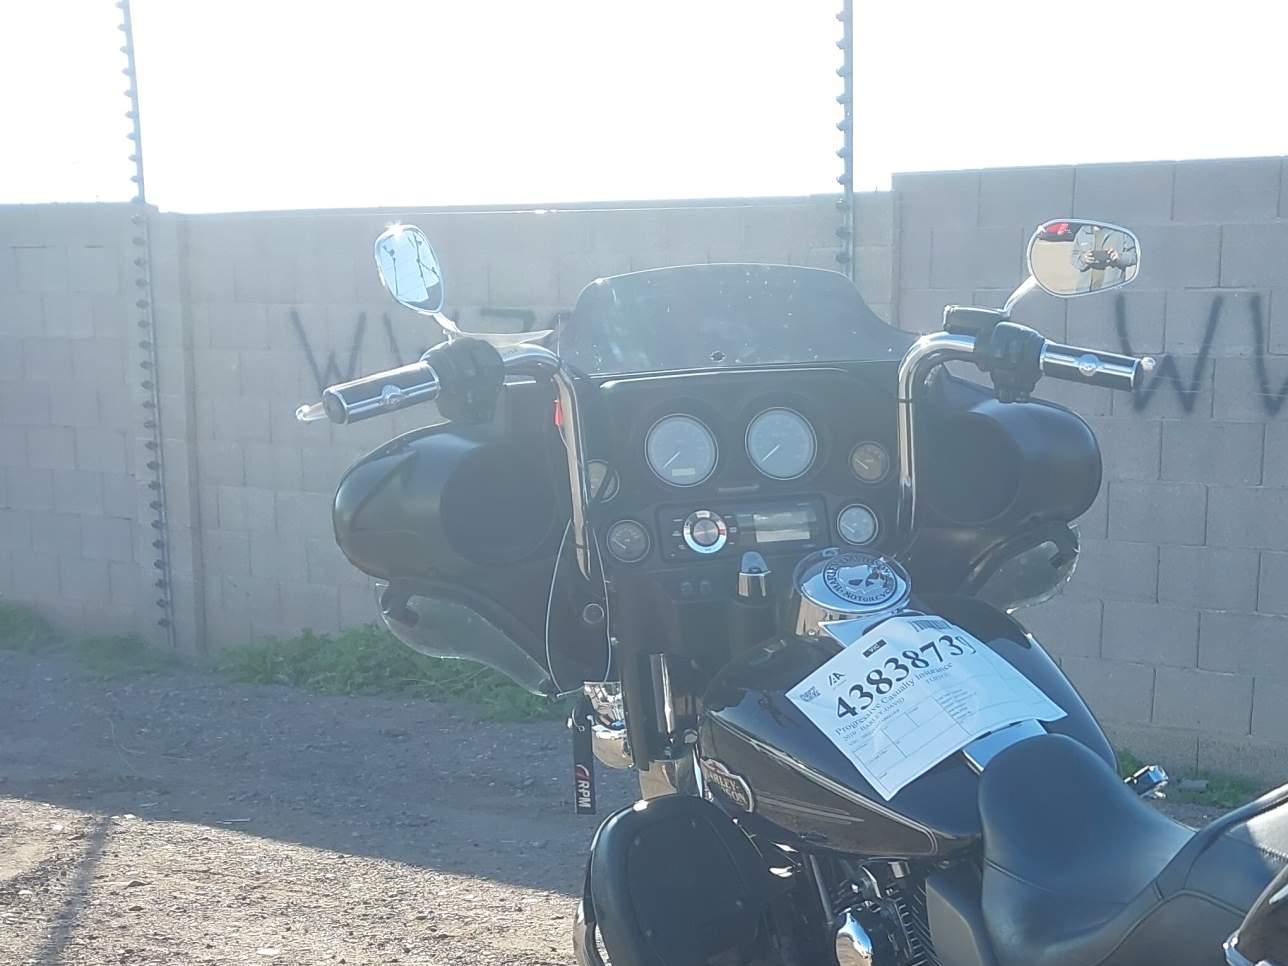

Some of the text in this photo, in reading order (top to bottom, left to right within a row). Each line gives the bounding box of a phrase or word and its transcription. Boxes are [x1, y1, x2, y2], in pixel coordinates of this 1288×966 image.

[835, 703, 880, 736] Progressive
[881, 677, 915, 704] Casualty
[915, 662, 953, 680] Insurance
[837, 634, 977, 718] 43838739
[577, 779, 592, 808] RPM
